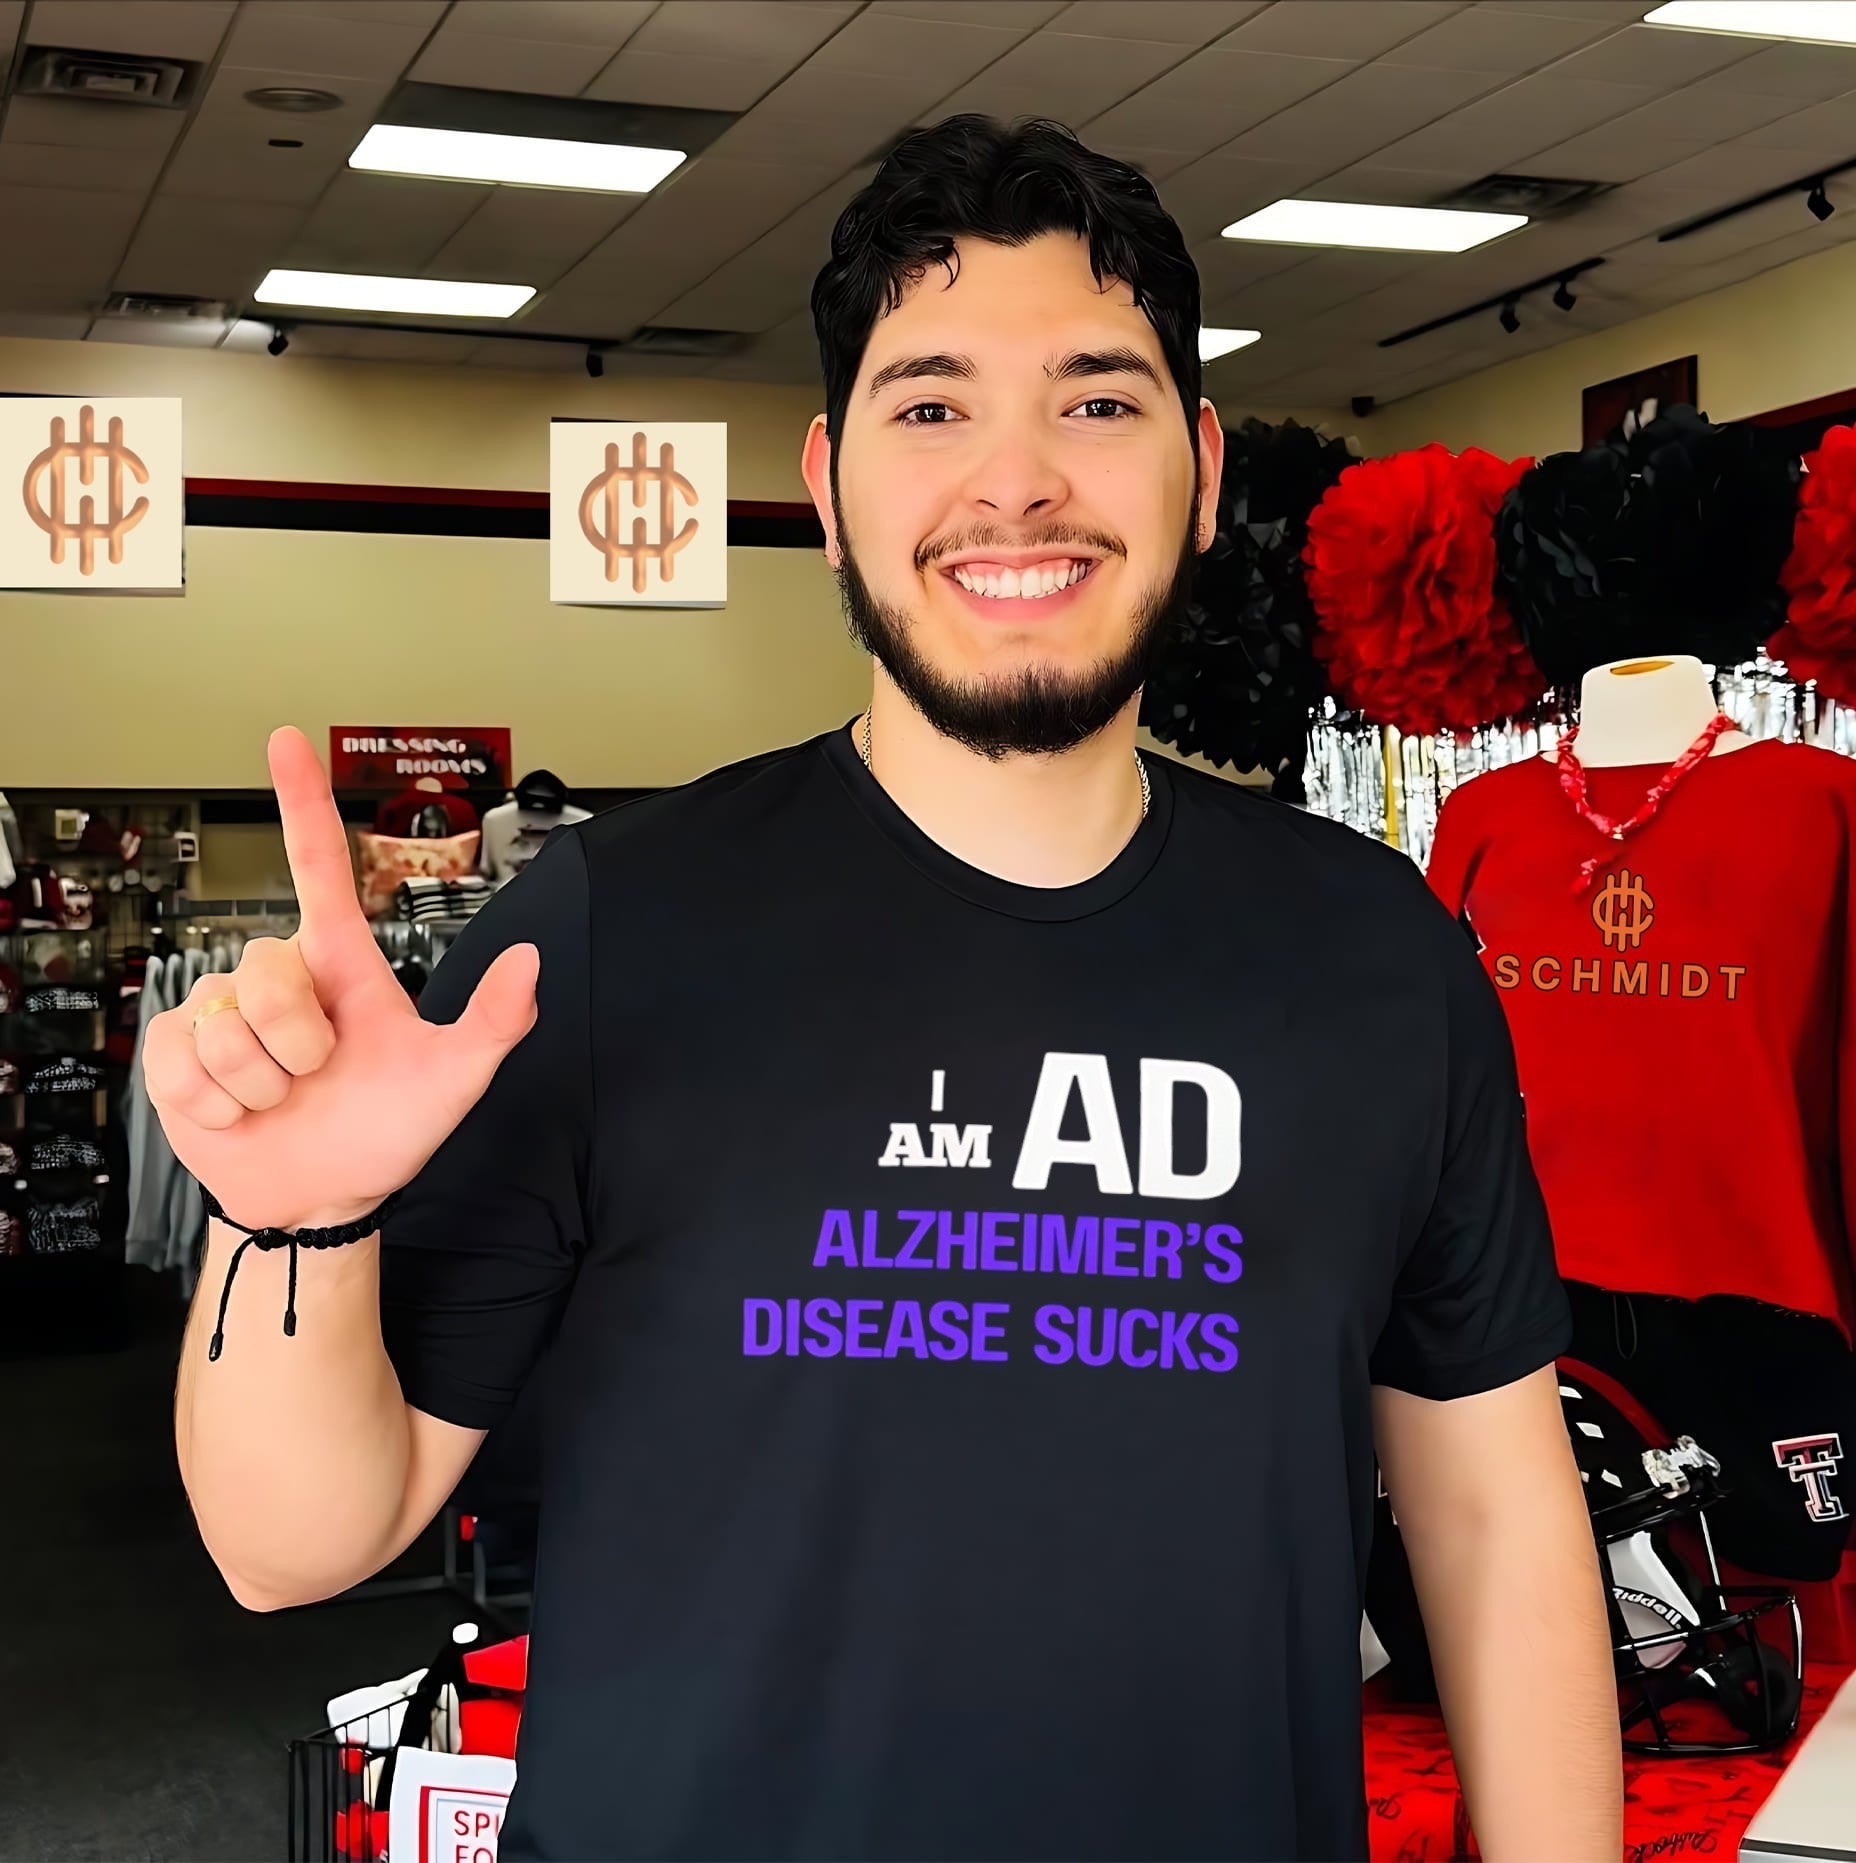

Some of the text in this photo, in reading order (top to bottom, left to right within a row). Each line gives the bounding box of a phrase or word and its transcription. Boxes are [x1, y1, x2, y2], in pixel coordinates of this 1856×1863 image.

[396, 758, 487, 776] ROOMS
[1494, 953, 1747, 1000] SCHMIDT
[931, 1070, 946, 1112] I
[878, 1051, 1242, 1200] AM AD
[812, 1208, 1244, 1284] ALZHEIMER'S
[743, 1297, 1240, 1372] DISEASE SUCKS
[454, 1810, 500, 1838] SPI
[456, 1844, 494, 1863] FO
